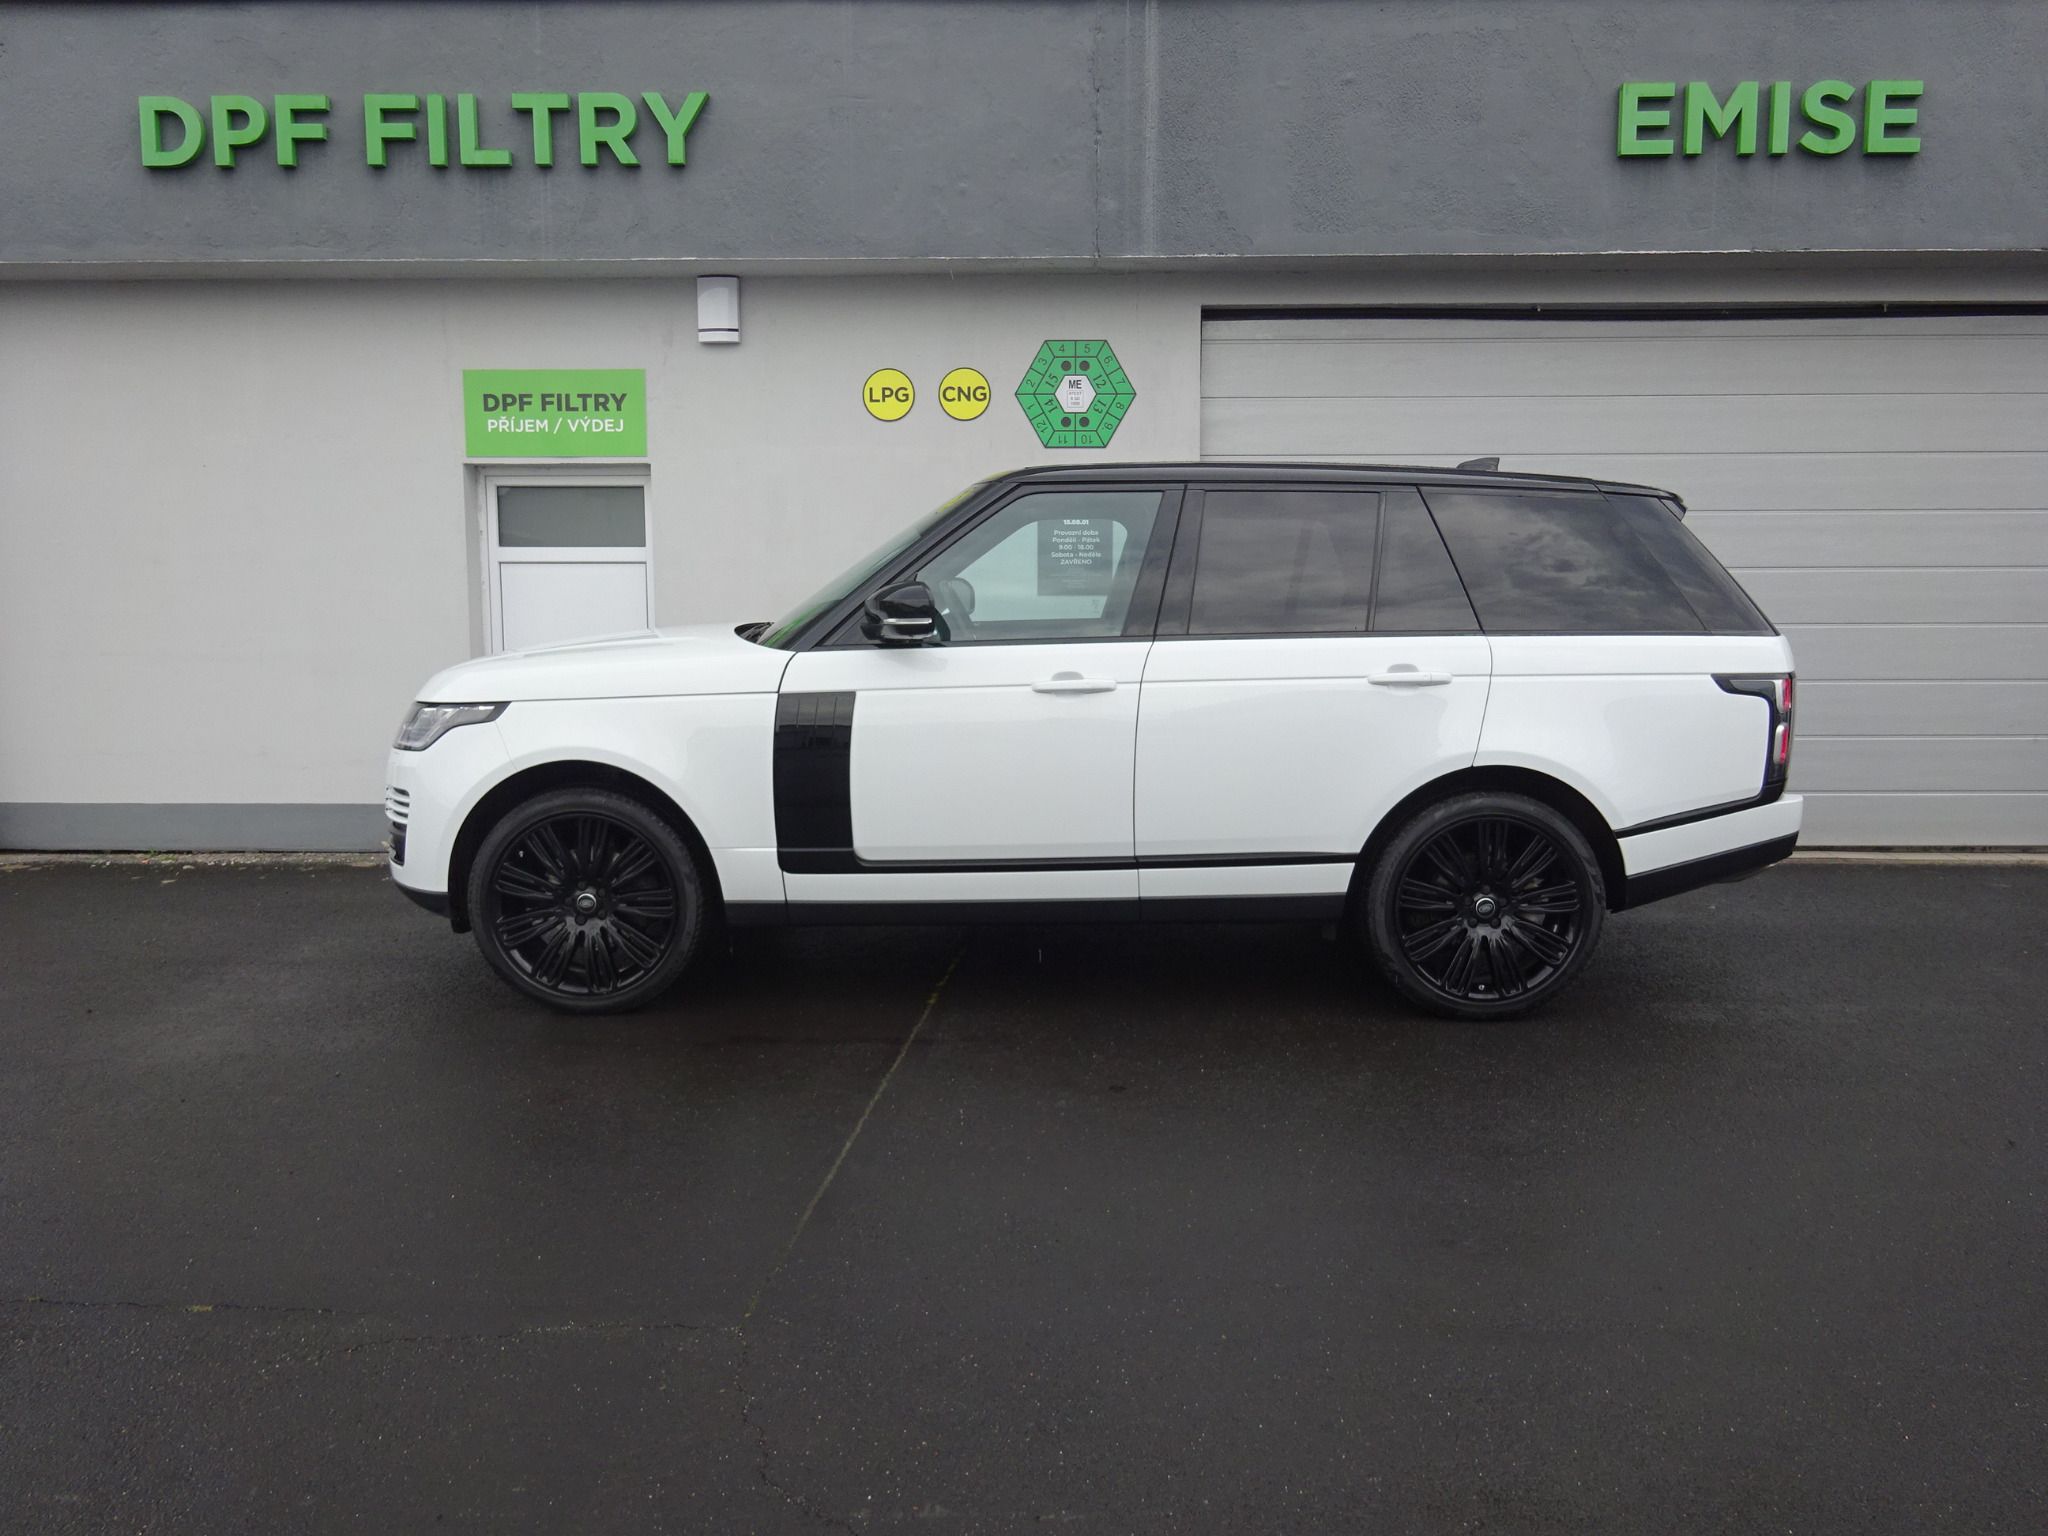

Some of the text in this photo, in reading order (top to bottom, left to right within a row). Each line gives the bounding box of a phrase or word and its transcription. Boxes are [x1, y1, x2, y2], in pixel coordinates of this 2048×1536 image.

[1617, 79, 1924, 157] EMISE
[138, 92, 710, 169] DPF FILTRY
[1059, 344, 1065, 353] 4
[1083, 344, 1091, 354] 5
[1038, 357, 1048, 366] 3
[1026, 378, 1036, 388] 2
[1045, 373, 1059, 388] 15
[1068, 379, 1082, 389] ME
[1092, 373, 1107, 388] 12
[1115, 378, 1126, 387] 7
[869, 386, 910, 403] LPG
[942, 385, 987, 402] CNG
[482, 393, 628, 412] DPF FILTRY
[1044, 398, 1059, 413] 14
[1094, 399, 1107, 414] 13
[1115, 401, 1124, 410] 8
[487, 416, 624, 434] PŘÍJEM / VÝDEJ
[1036, 420, 1049, 433] 12
[1058, 435, 1068, 444] 11
[1081, 434, 1093, 444] 10
